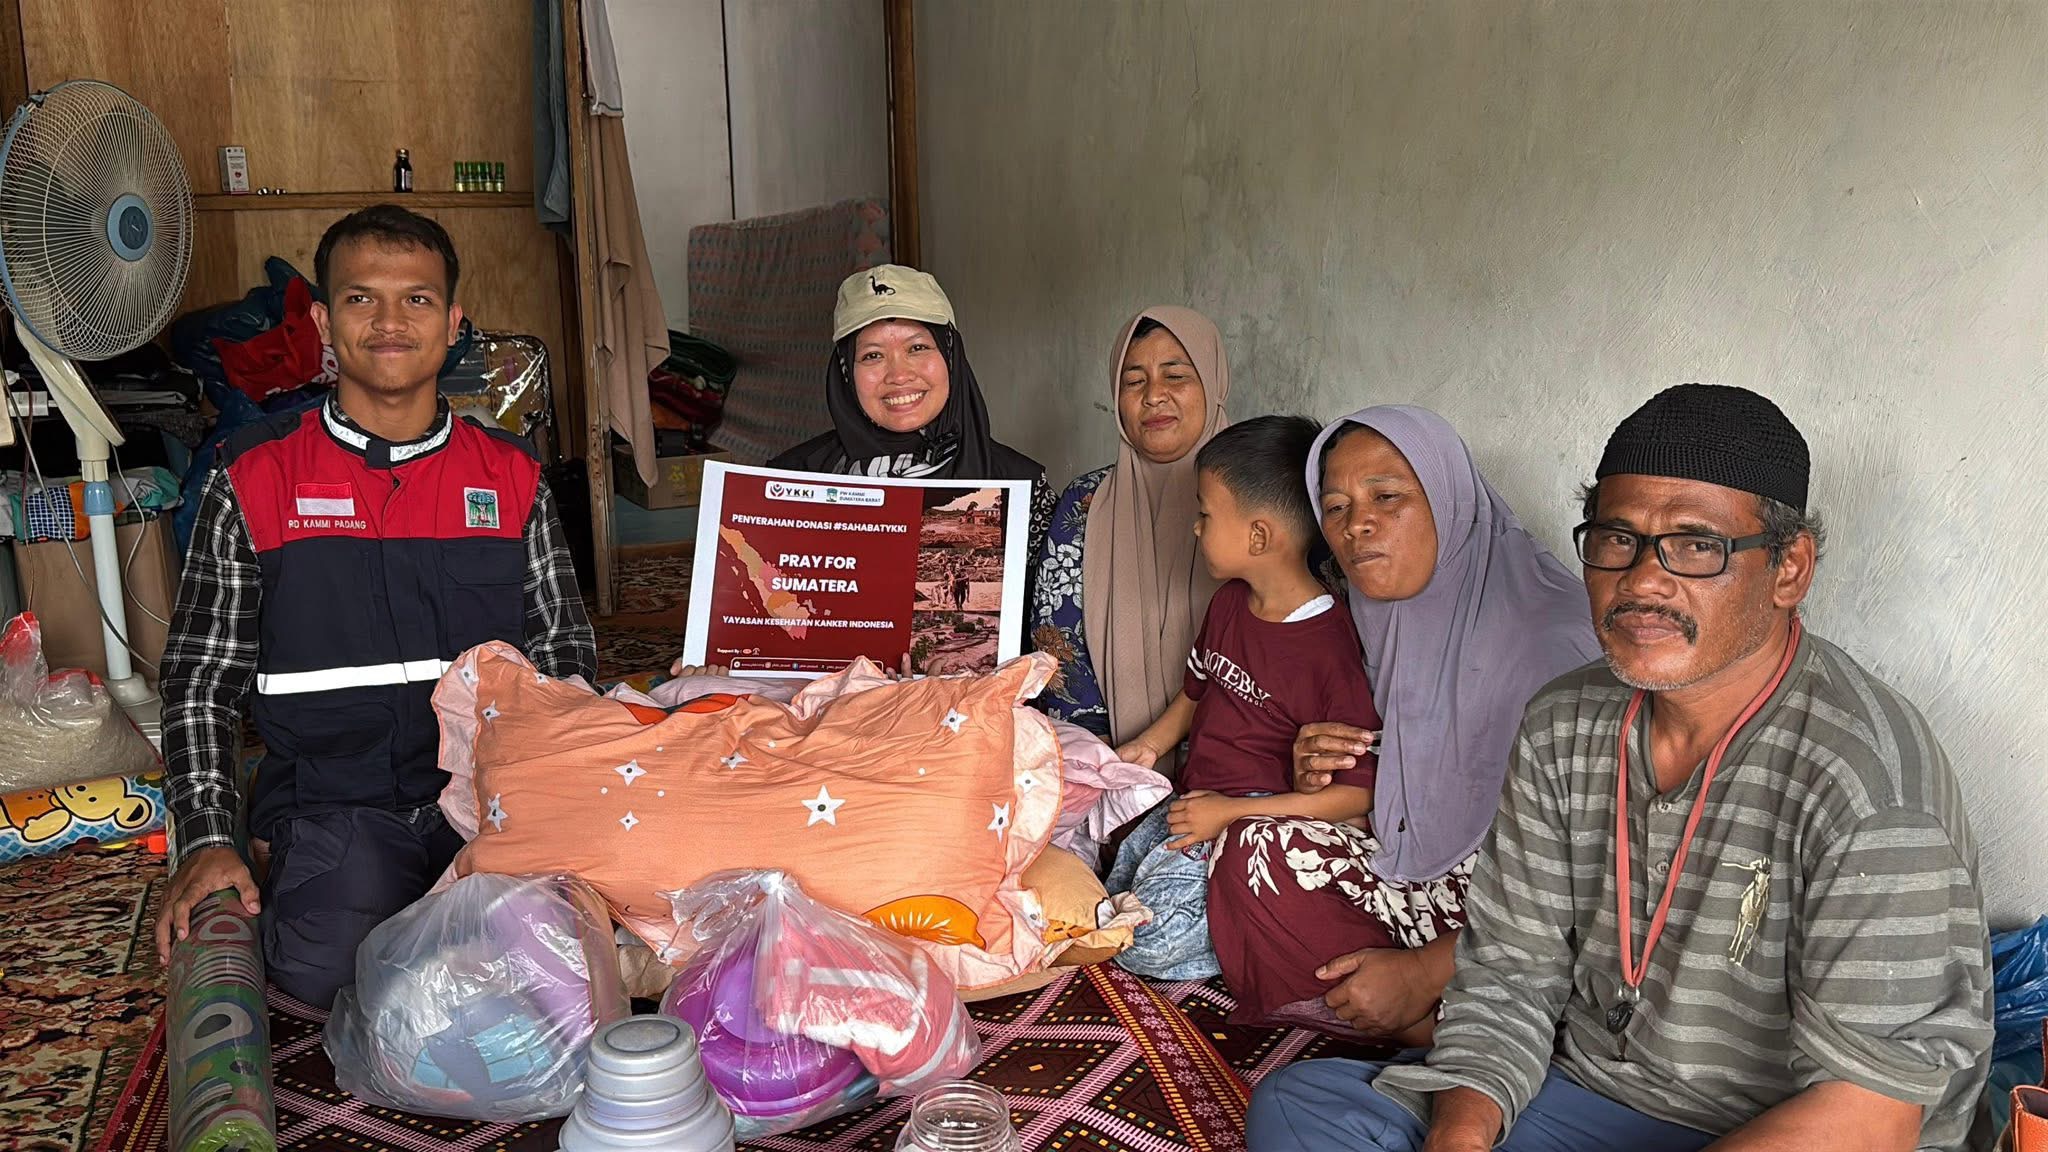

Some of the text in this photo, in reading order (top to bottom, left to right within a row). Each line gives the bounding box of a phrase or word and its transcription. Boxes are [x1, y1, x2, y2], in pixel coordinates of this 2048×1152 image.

[786, 487, 815, 498] YKKI
[303, 519, 331, 529] KAMMI
[334, 519, 367, 530] PADANG
[731, 513, 908, 533] PENYERAHAN DONASI #SAHABATYKKI
[779, 553, 857, 570] PRAY FOR
[771, 576, 859, 593] SUMATERA
[722, 615, 894, 629] YAYASAN KESEHATAN KANKER INDONESIA
